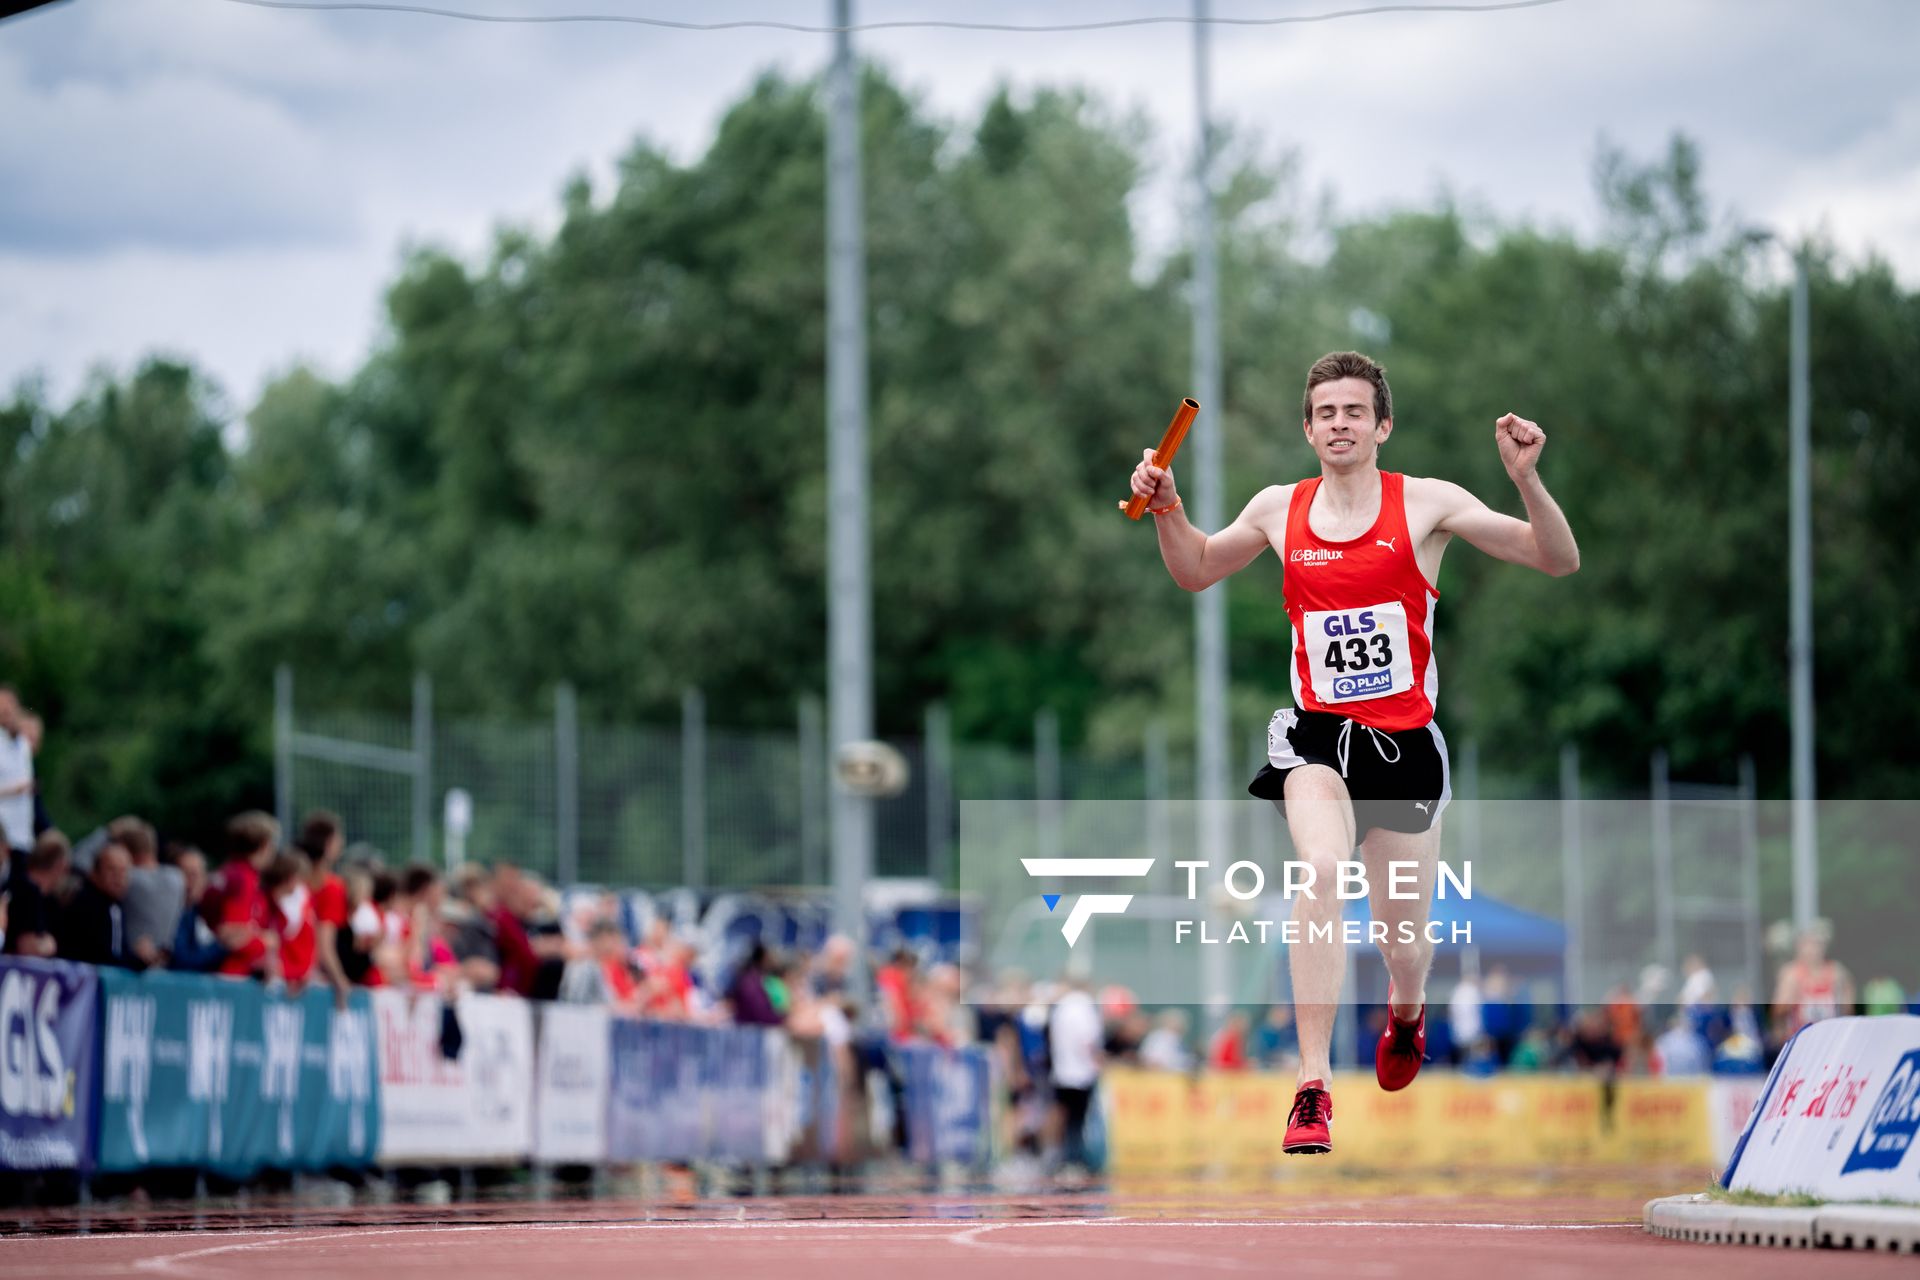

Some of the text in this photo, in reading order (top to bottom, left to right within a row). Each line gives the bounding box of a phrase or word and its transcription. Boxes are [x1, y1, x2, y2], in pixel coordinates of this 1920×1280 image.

[1304, 549, 1343, 561] Brillux
[1325, 633, 1393, 672] 433
[1357, 674, 1390, 688] PLAN
